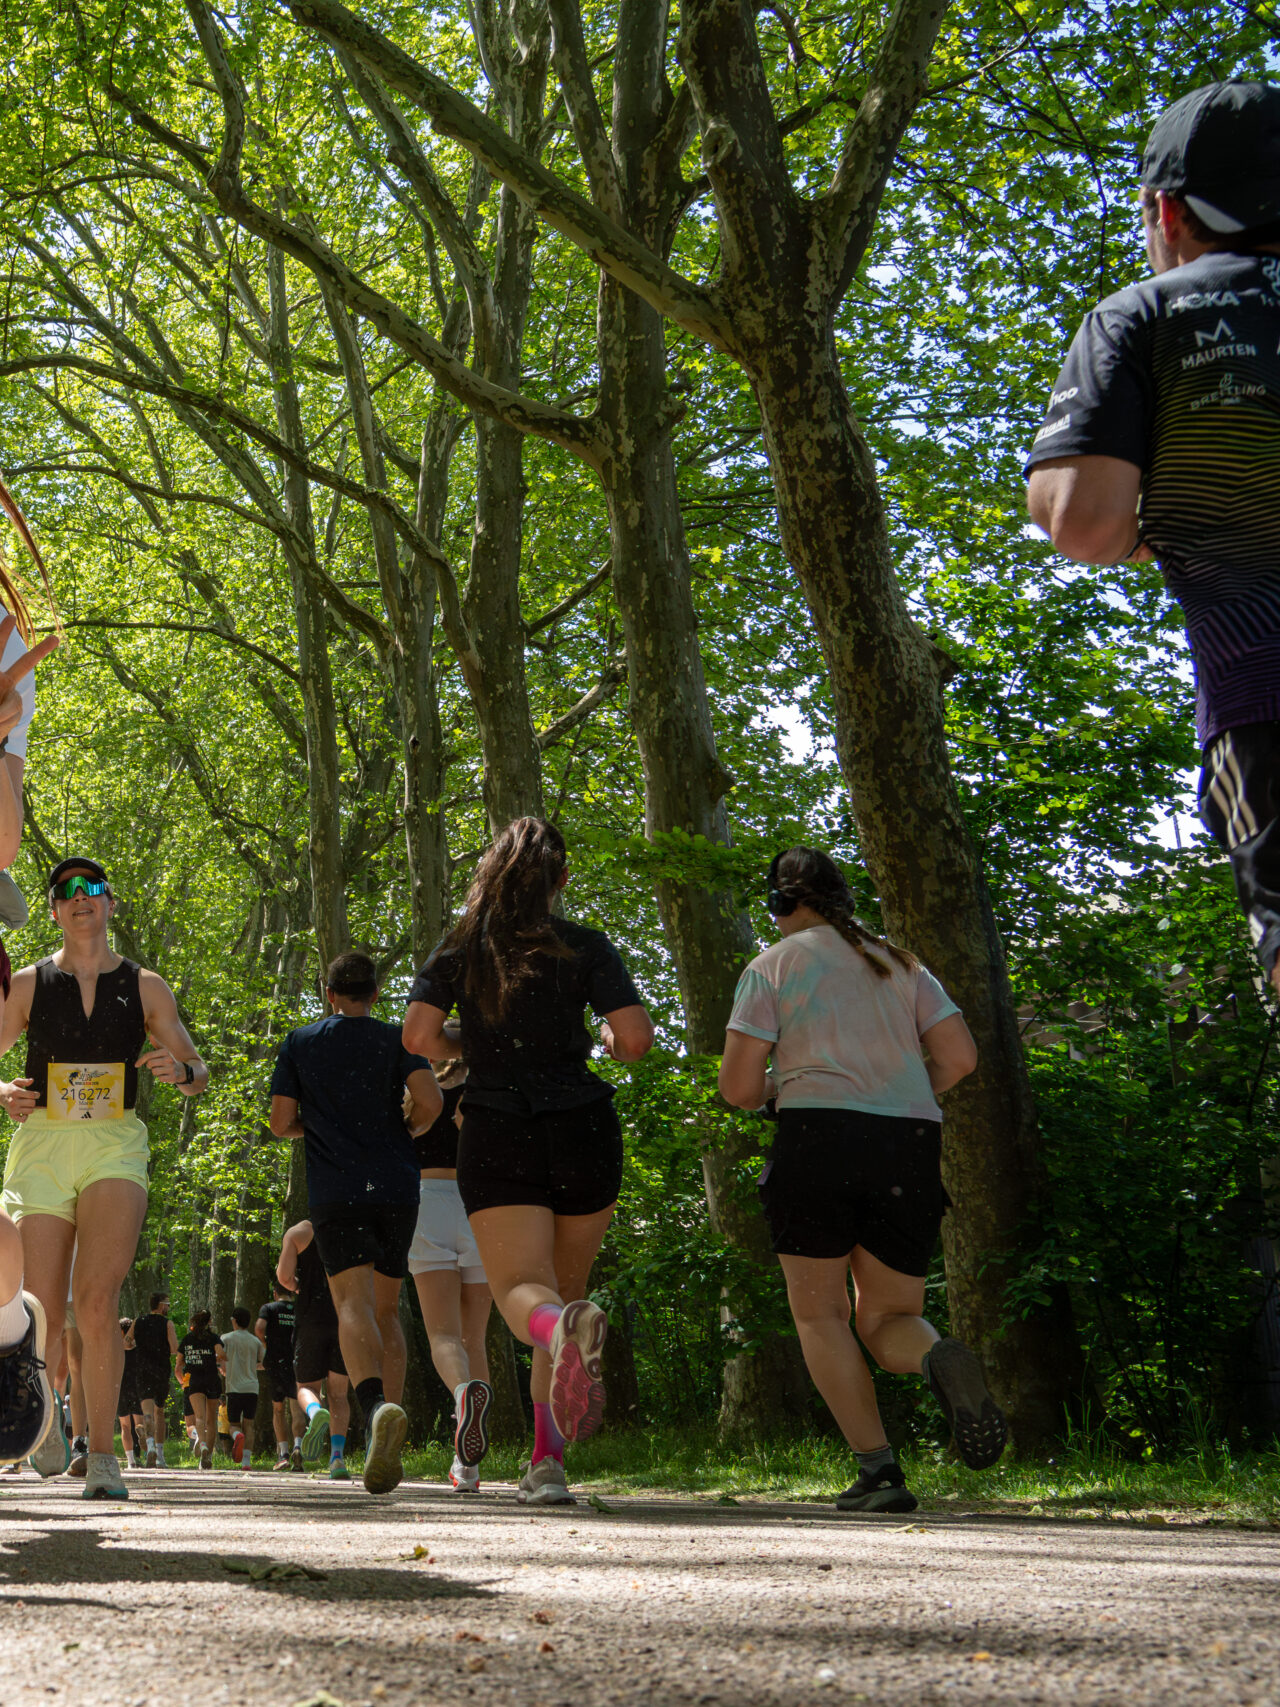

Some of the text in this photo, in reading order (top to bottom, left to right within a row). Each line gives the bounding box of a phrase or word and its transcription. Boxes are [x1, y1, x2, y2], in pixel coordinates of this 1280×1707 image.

[1165, 290, 1241, 319] HOKA
[1181, 343, 1257, 370] MAURTEN
[1190, 384, 1266, 411] BREITLING
[61, 1087, 110, 1101] 216272
